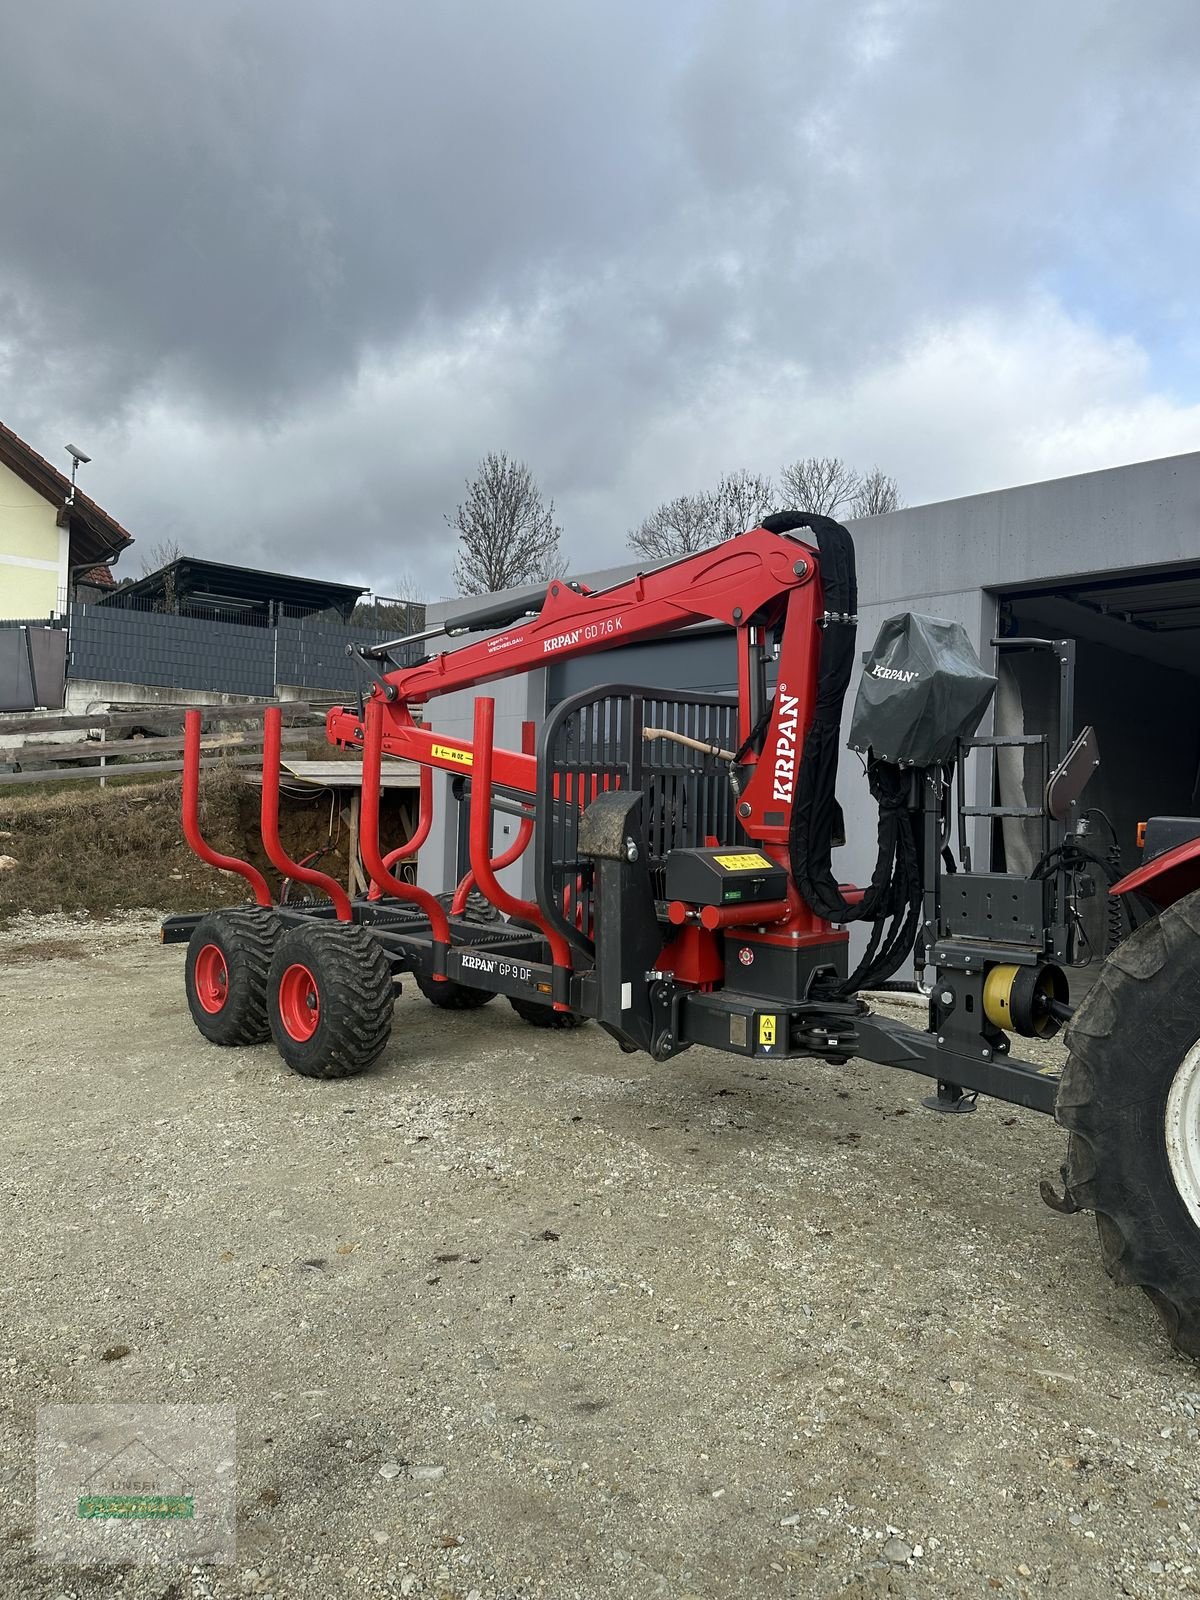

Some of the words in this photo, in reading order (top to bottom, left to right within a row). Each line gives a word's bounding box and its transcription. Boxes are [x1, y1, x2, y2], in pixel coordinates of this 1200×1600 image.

[584, 625, 598, 639] GD
[600, 621, 614, 635] 7,6
[615, 616, 623, 630] K
[499, 963, 511, 976] GP
[512, 966, 518, 978] 9
[520, 967, 532, 980] DF
